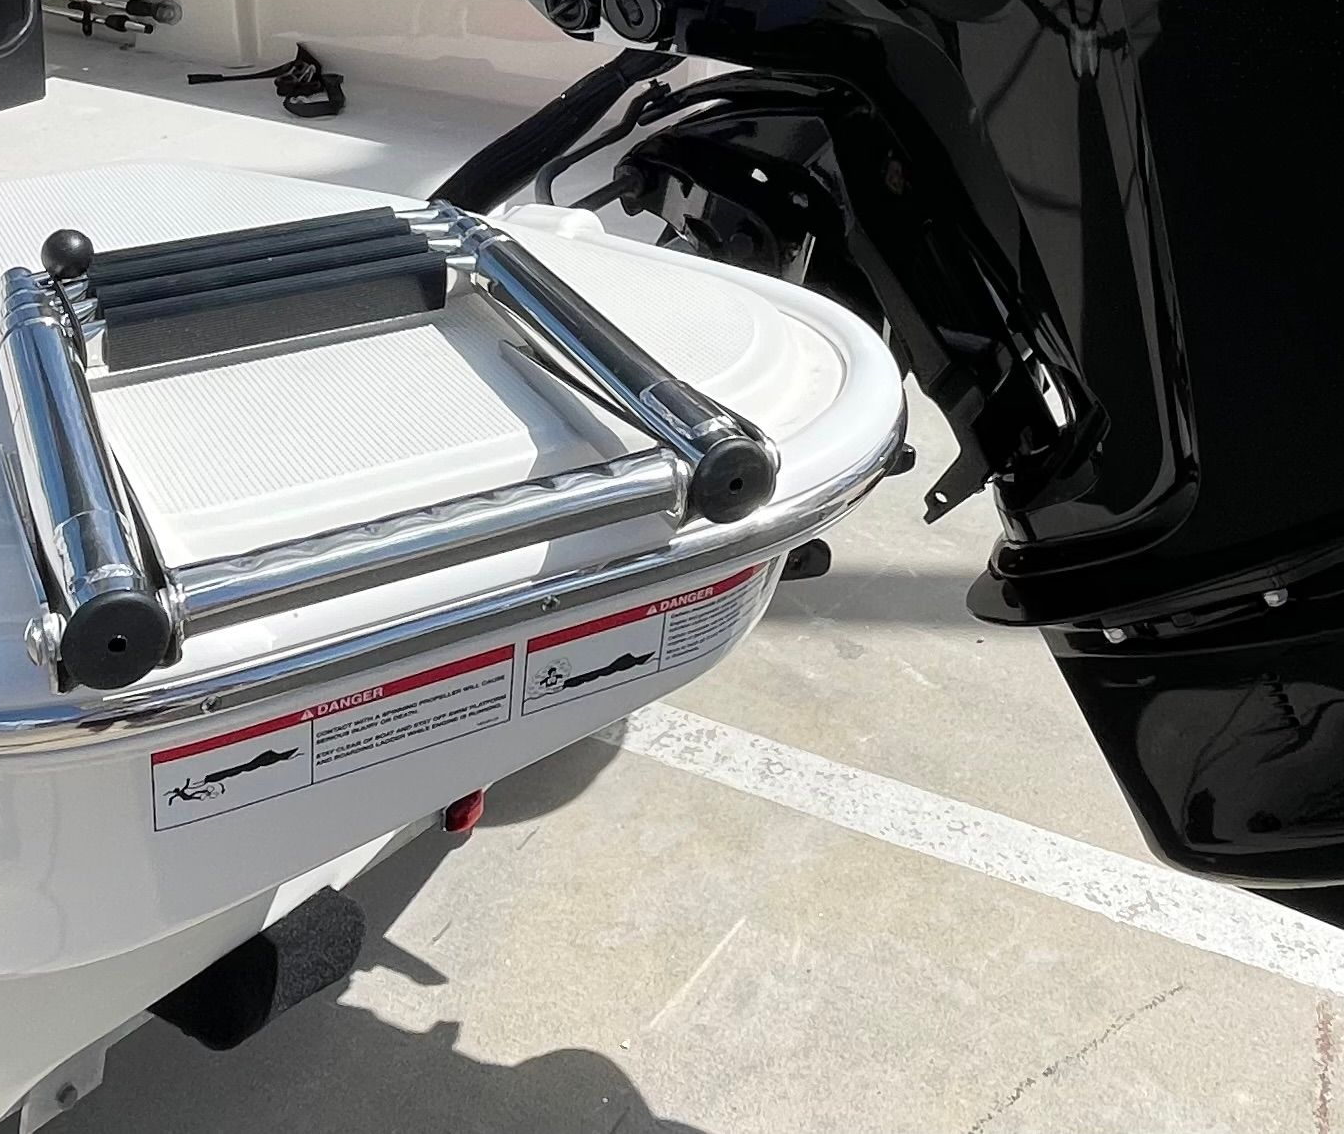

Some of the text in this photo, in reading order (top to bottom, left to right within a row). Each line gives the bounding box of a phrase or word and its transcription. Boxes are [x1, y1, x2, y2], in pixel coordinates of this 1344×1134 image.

[660, 586, 714, 612] DANGER
[317, 686, 384, 716] DANGER
[419, 688, 462, 705] PROPELLER
